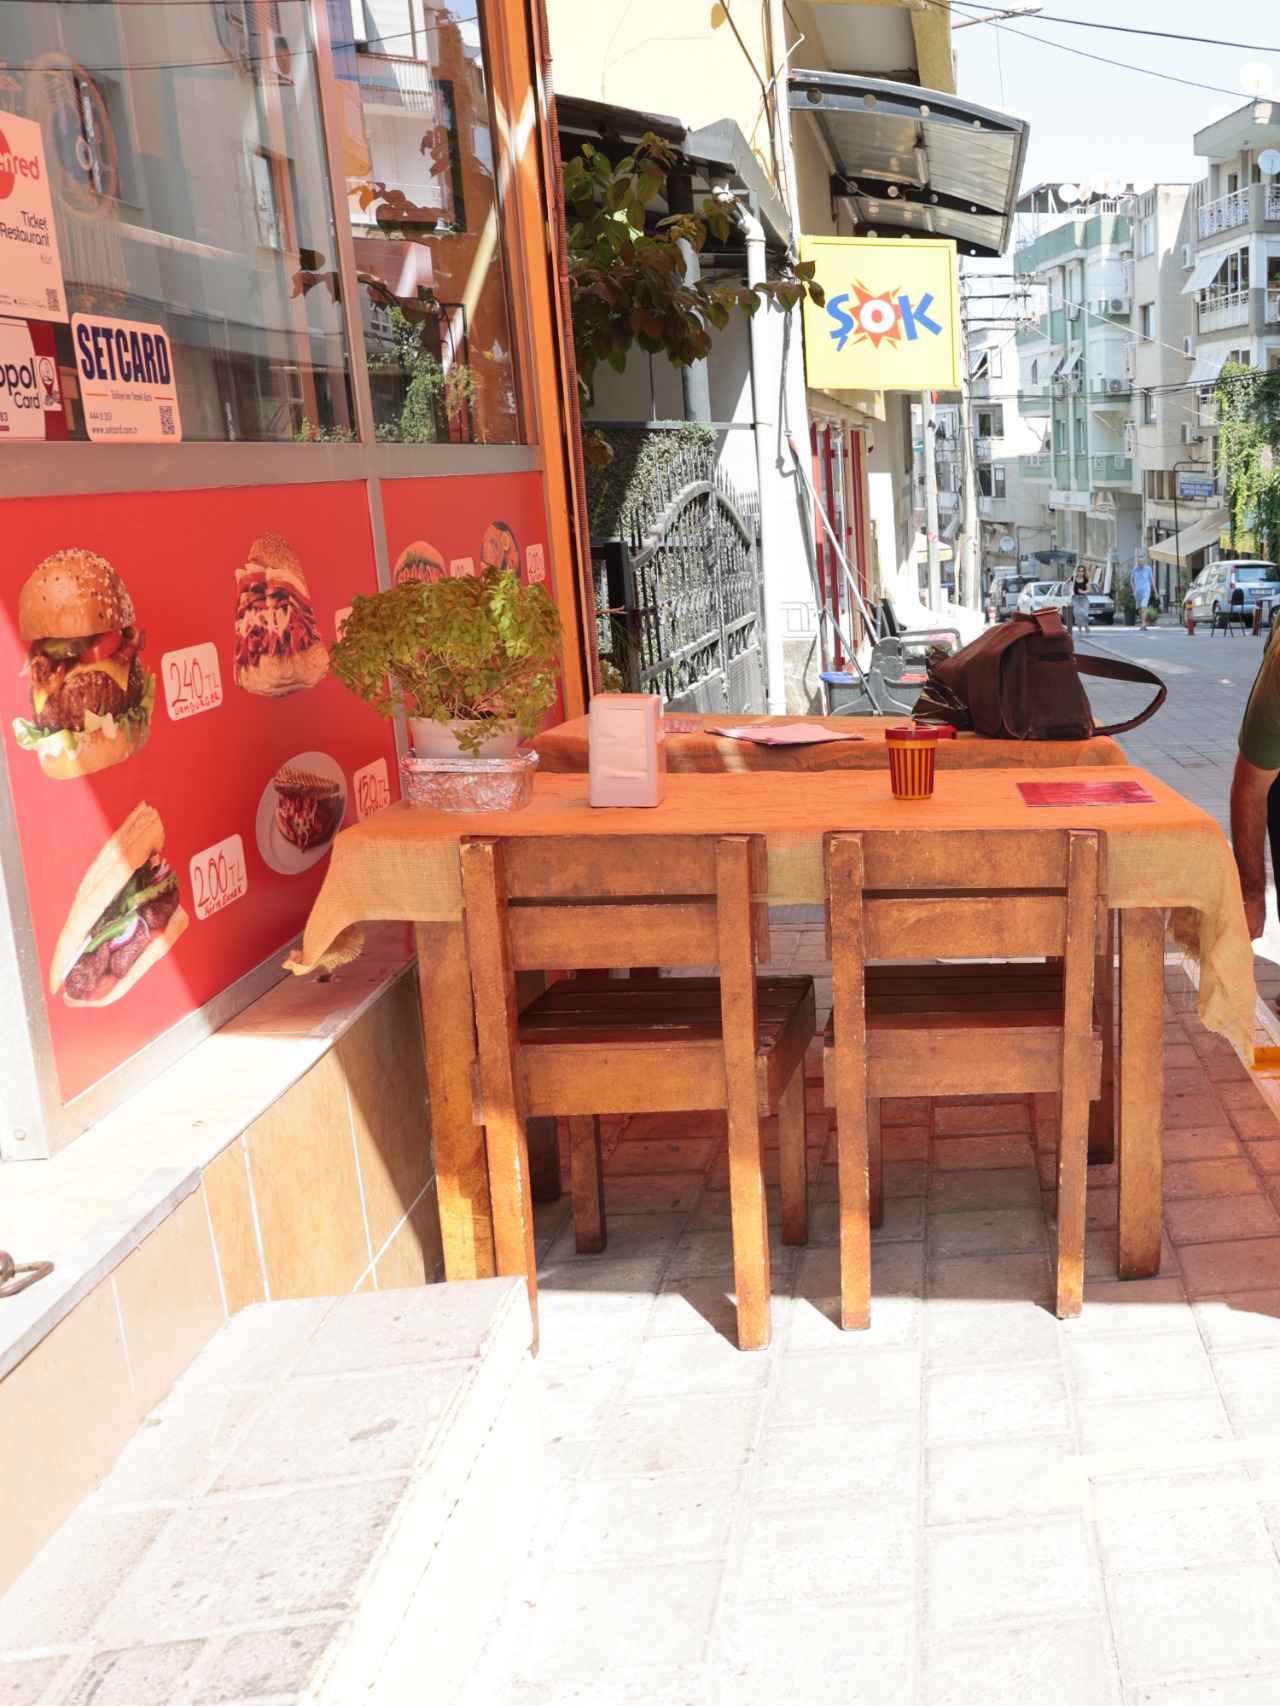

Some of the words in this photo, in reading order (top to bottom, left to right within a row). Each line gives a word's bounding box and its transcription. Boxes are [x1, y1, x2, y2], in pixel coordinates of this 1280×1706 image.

[0, 222, 50, 247] Restaurant
[20, 211, 48, 231] Ticket
[826, 292, 943, 352] ŞOK
[77, 323, 171, 385] SETCARD
[14, 391, 40, 409] Card
[169, 658, 204, 708] 240
